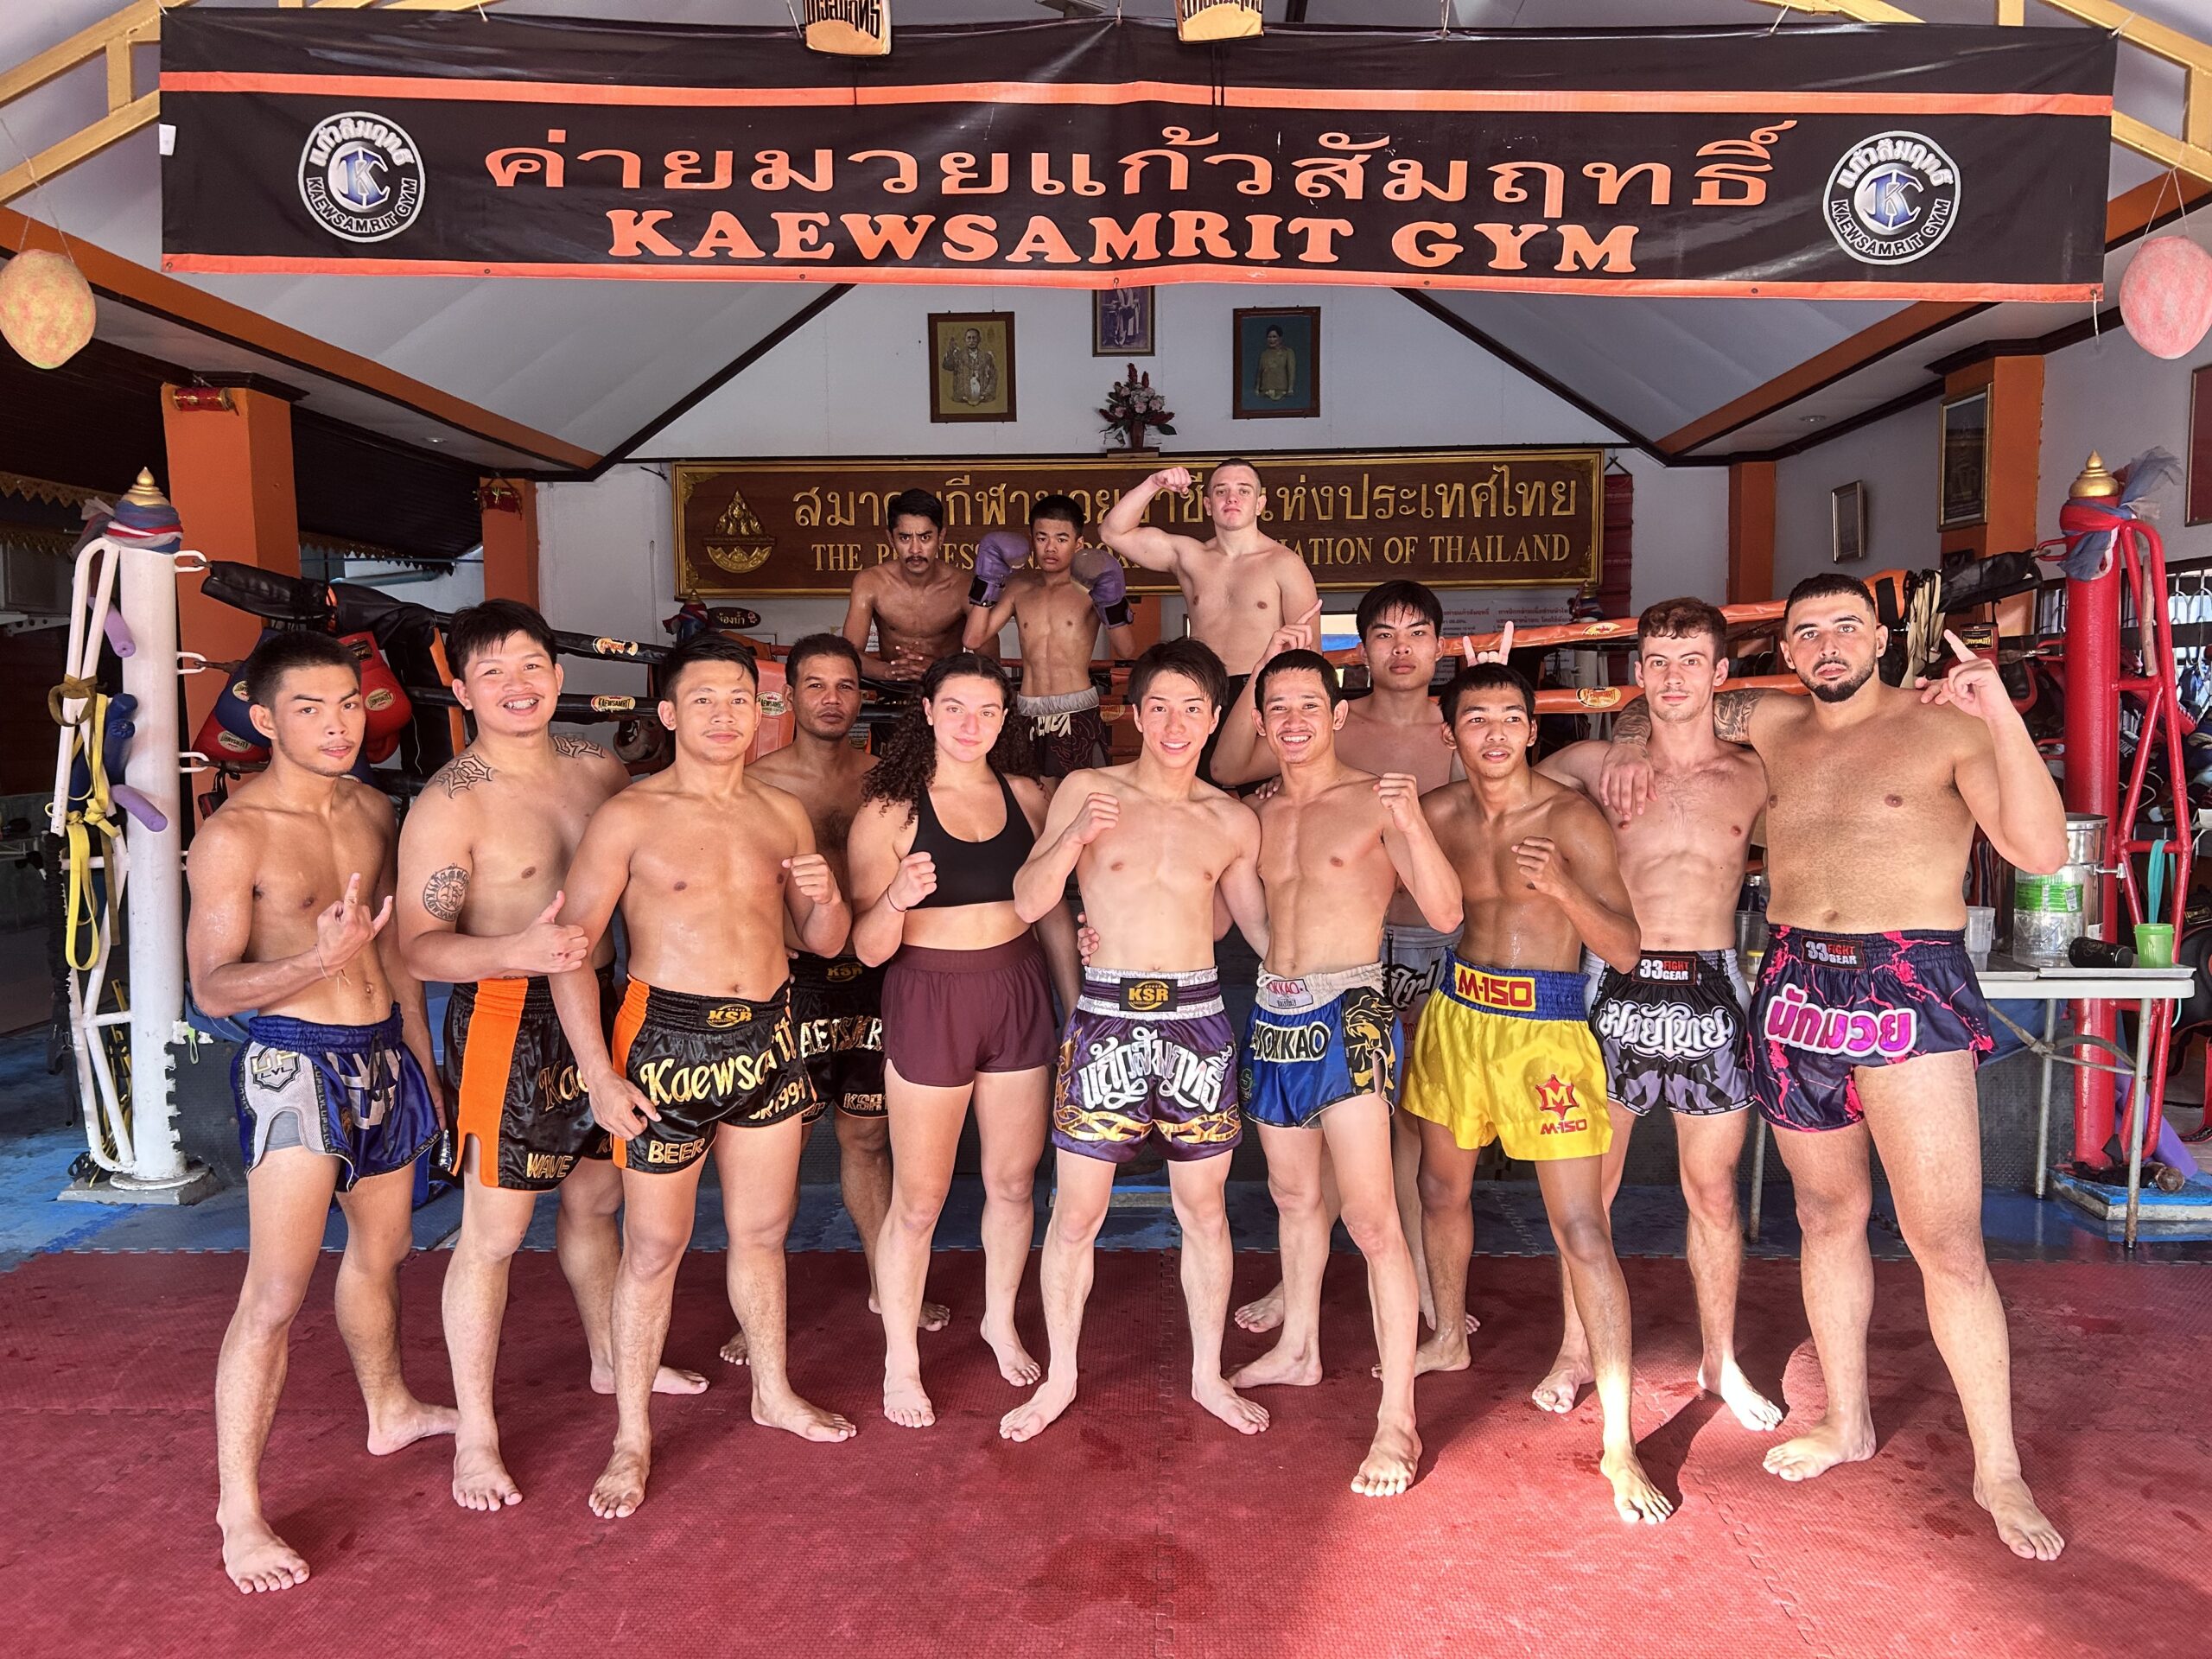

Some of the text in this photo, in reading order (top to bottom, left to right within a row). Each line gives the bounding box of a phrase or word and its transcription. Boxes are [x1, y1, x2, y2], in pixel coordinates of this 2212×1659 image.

[485, 119, 1797, 219] ค่ายมวยแก้วสัมฤทธิ์
[306, 176, 418, 233] KAEWSAMRIT GYM
[1831, 198, 1951, 257] KAEWSAMRIT GYM
[605, 208, 1640, 273] KAEWSAMRIT GYM
[811, 543, 864, 571] THE
[1384, 536, 1418, 564] OF
[1428, 533, 1571, 564] THAILAND
[1805, 940, 1827, 961] 33
[1826, 944, 1855, 955] FIGHT
[1828, 954, 1857, 965] GEAR
[1639, 959, 1663, 978] 33
[1662, 960, 1689, 970] FIGHT
[1662, 970, 1688, 980] GEAR
[1128, 988, 1169, 1001] KSR
[708, 1009, 752, 1021] KSR
[1765, 985, 1916, 1056] นักมวย
[1253, 1020, 1332, 1063] YOKKAO
[261, 1066, 294, 1078] LVL
[648, 1137, 706, 1164] BEER
[526, 1152, 574, 1179] WAVE
